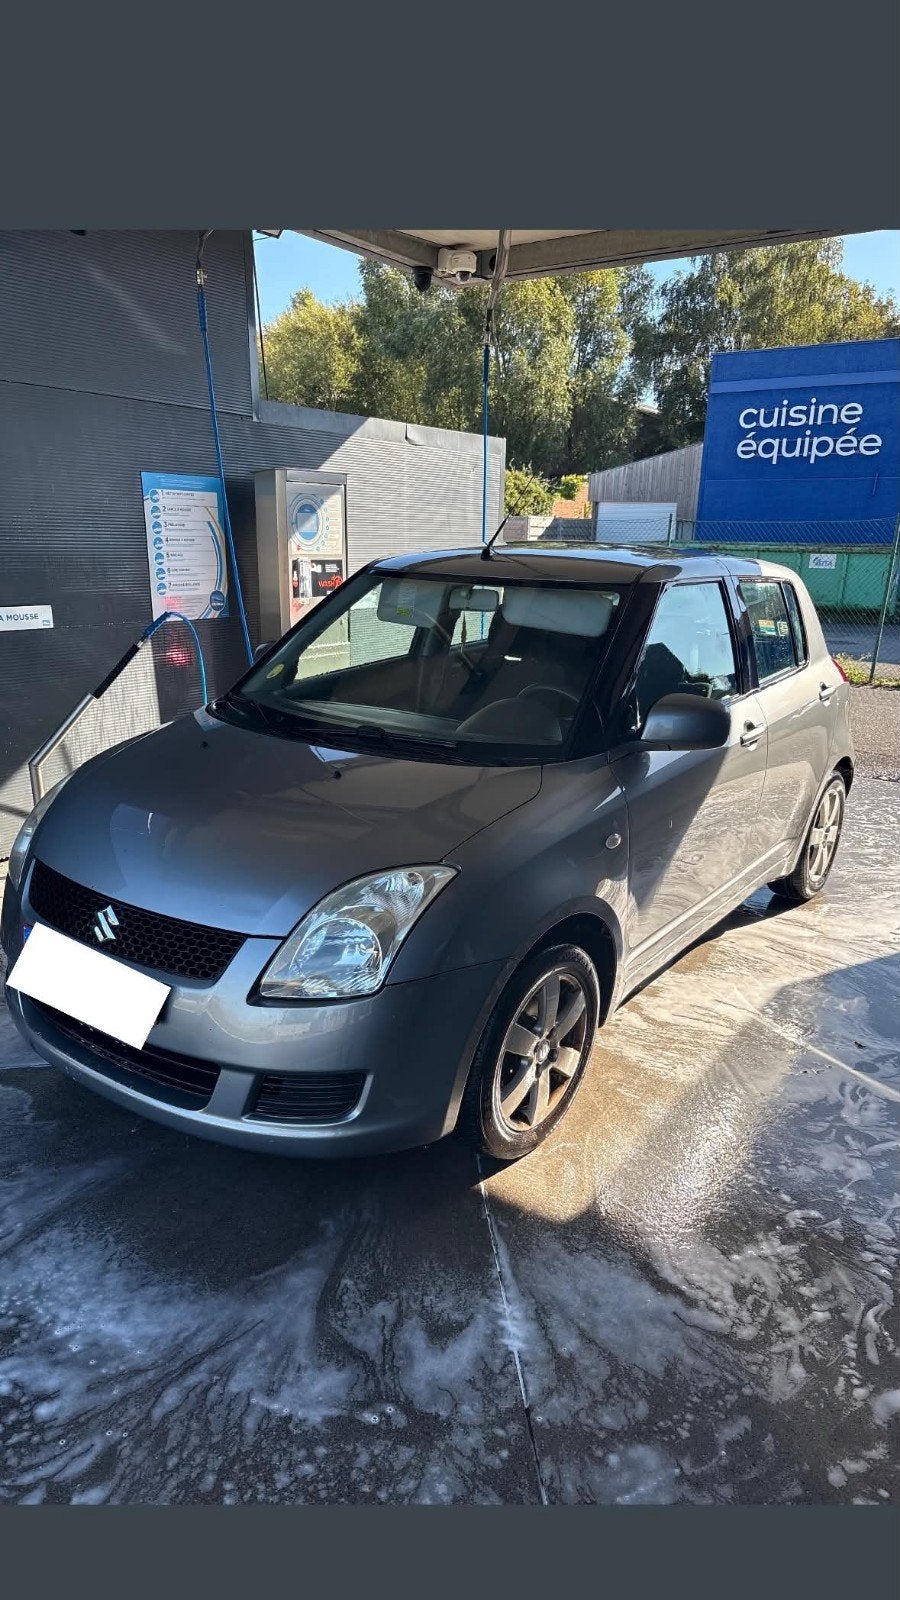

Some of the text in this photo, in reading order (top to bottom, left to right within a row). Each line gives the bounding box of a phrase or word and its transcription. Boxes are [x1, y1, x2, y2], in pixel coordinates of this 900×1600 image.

[738, 398, 863, 429] cuisine
[736, 427, 882, 465] équipée
[6, 613, 39, 621] MOUSSE
